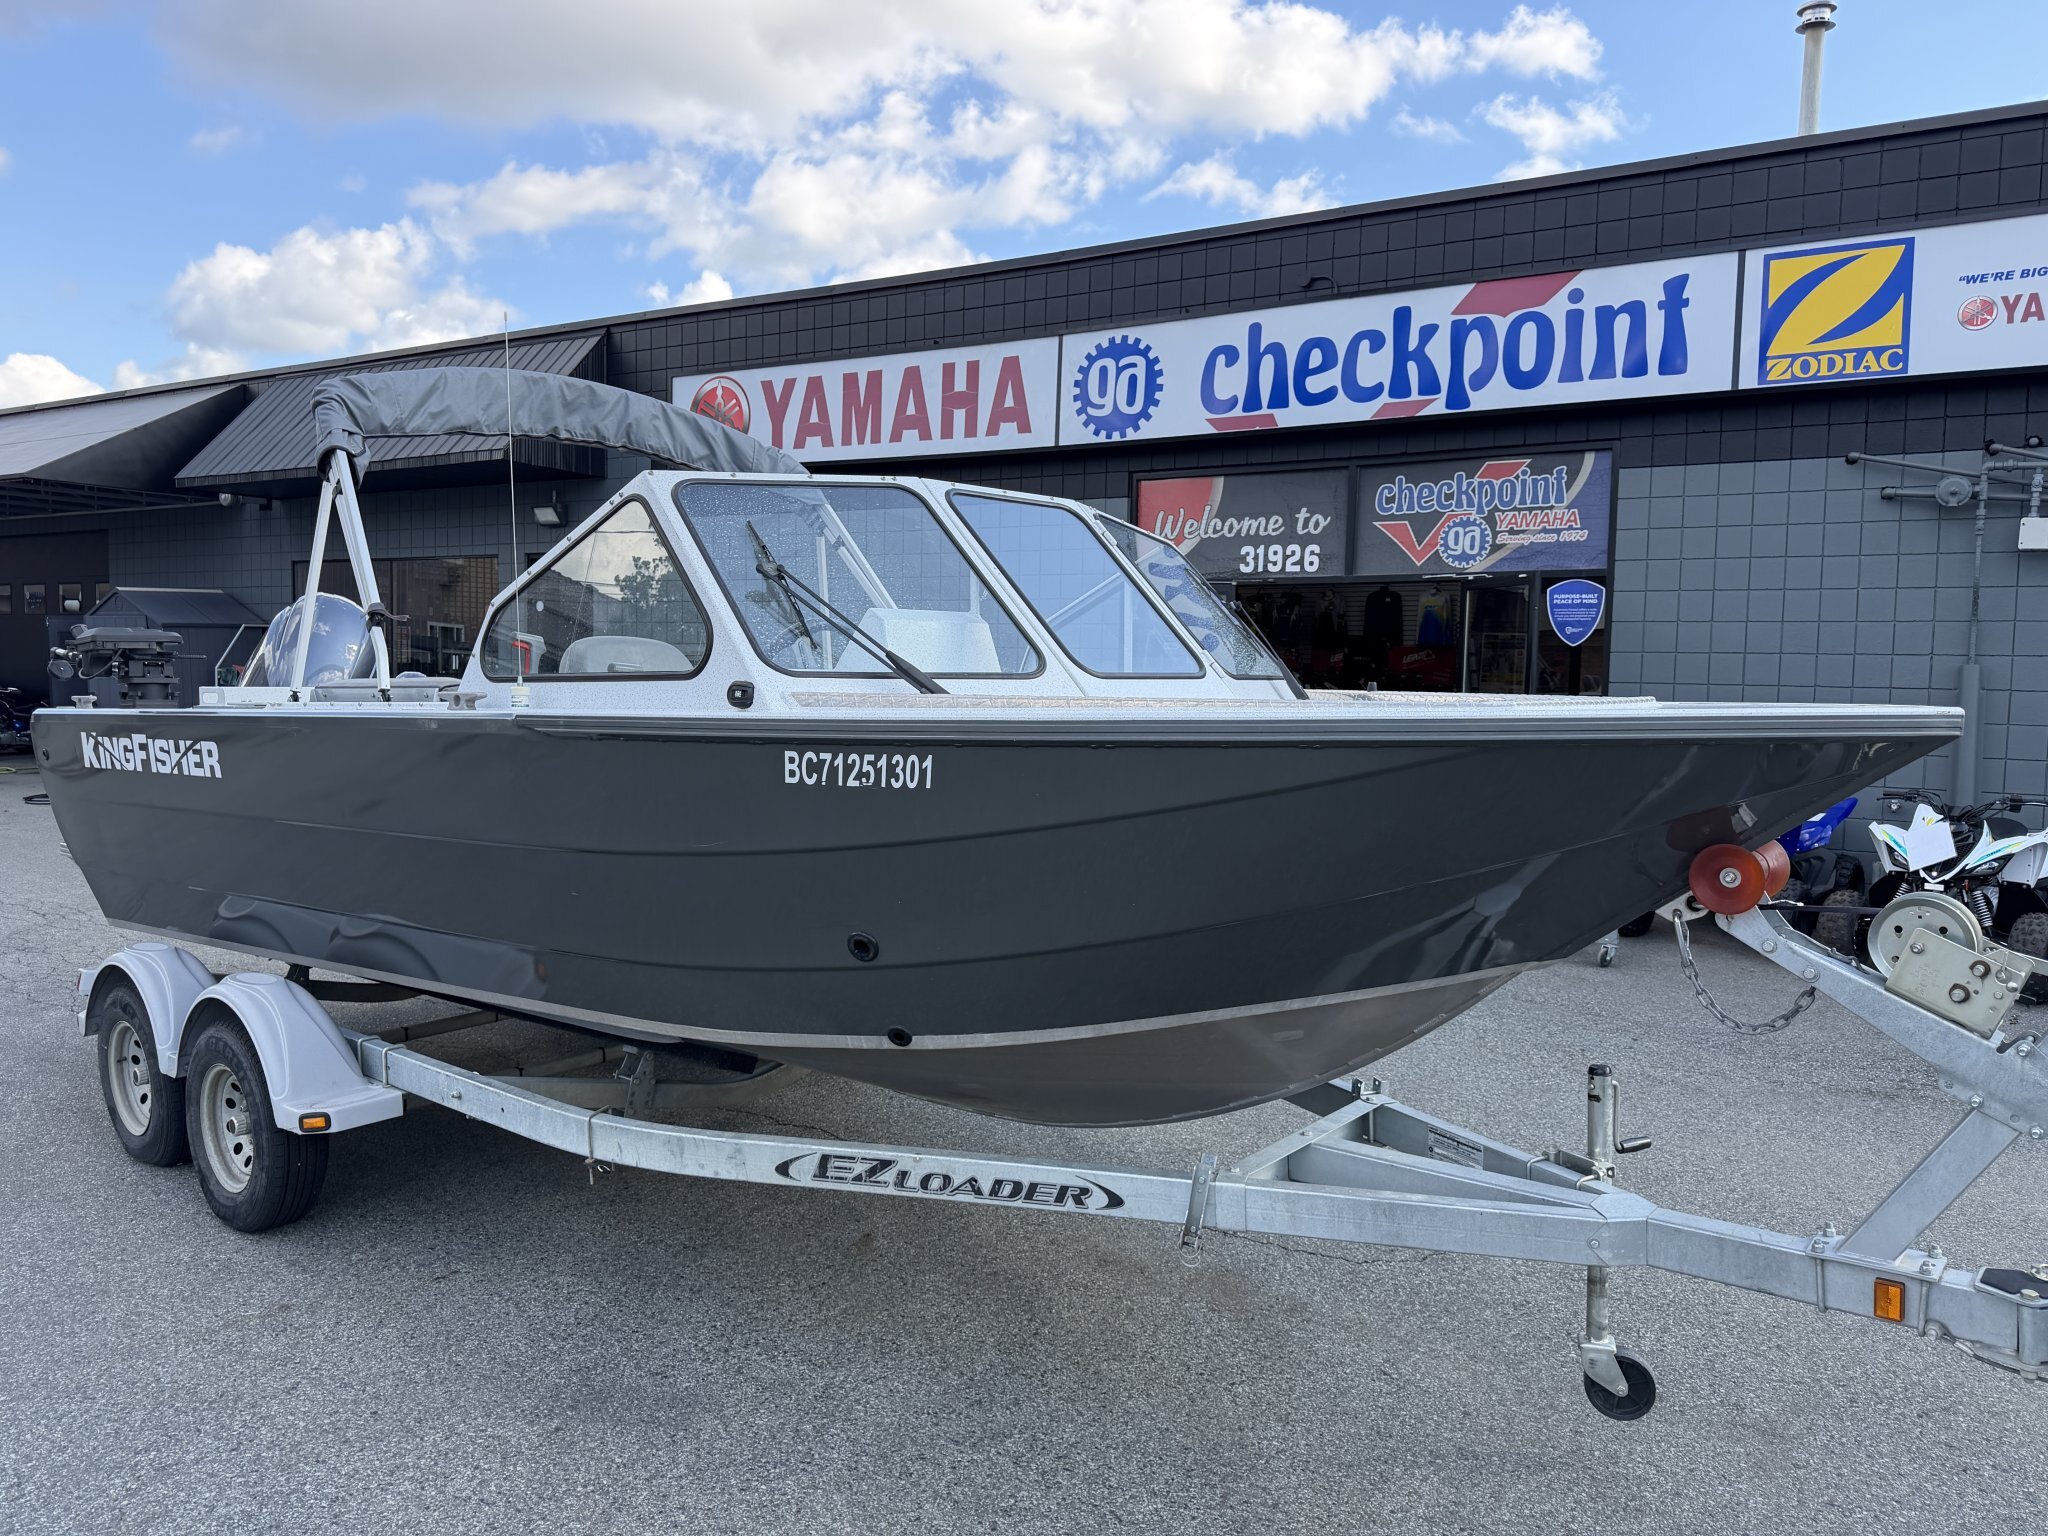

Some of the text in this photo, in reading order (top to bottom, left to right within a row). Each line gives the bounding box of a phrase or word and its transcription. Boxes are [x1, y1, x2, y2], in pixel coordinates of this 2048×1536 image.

[1200, 273, 1690, 415] checkpoint
[1766, 348, 1904, 381] ZODIAC
[760, 355, 1032, 449] YAMAHA
[1376, 466, 1567, 516] checkpoint
[1154, 504, 1331, 540] Welcome to
[1495, 509, 1580, 531] YAMAHA
[1496, 530, 1588, 545] Serving since 1974
[1239, 544, 1321, 574] 31926
[784, 750, 933, 789] BC71251301
